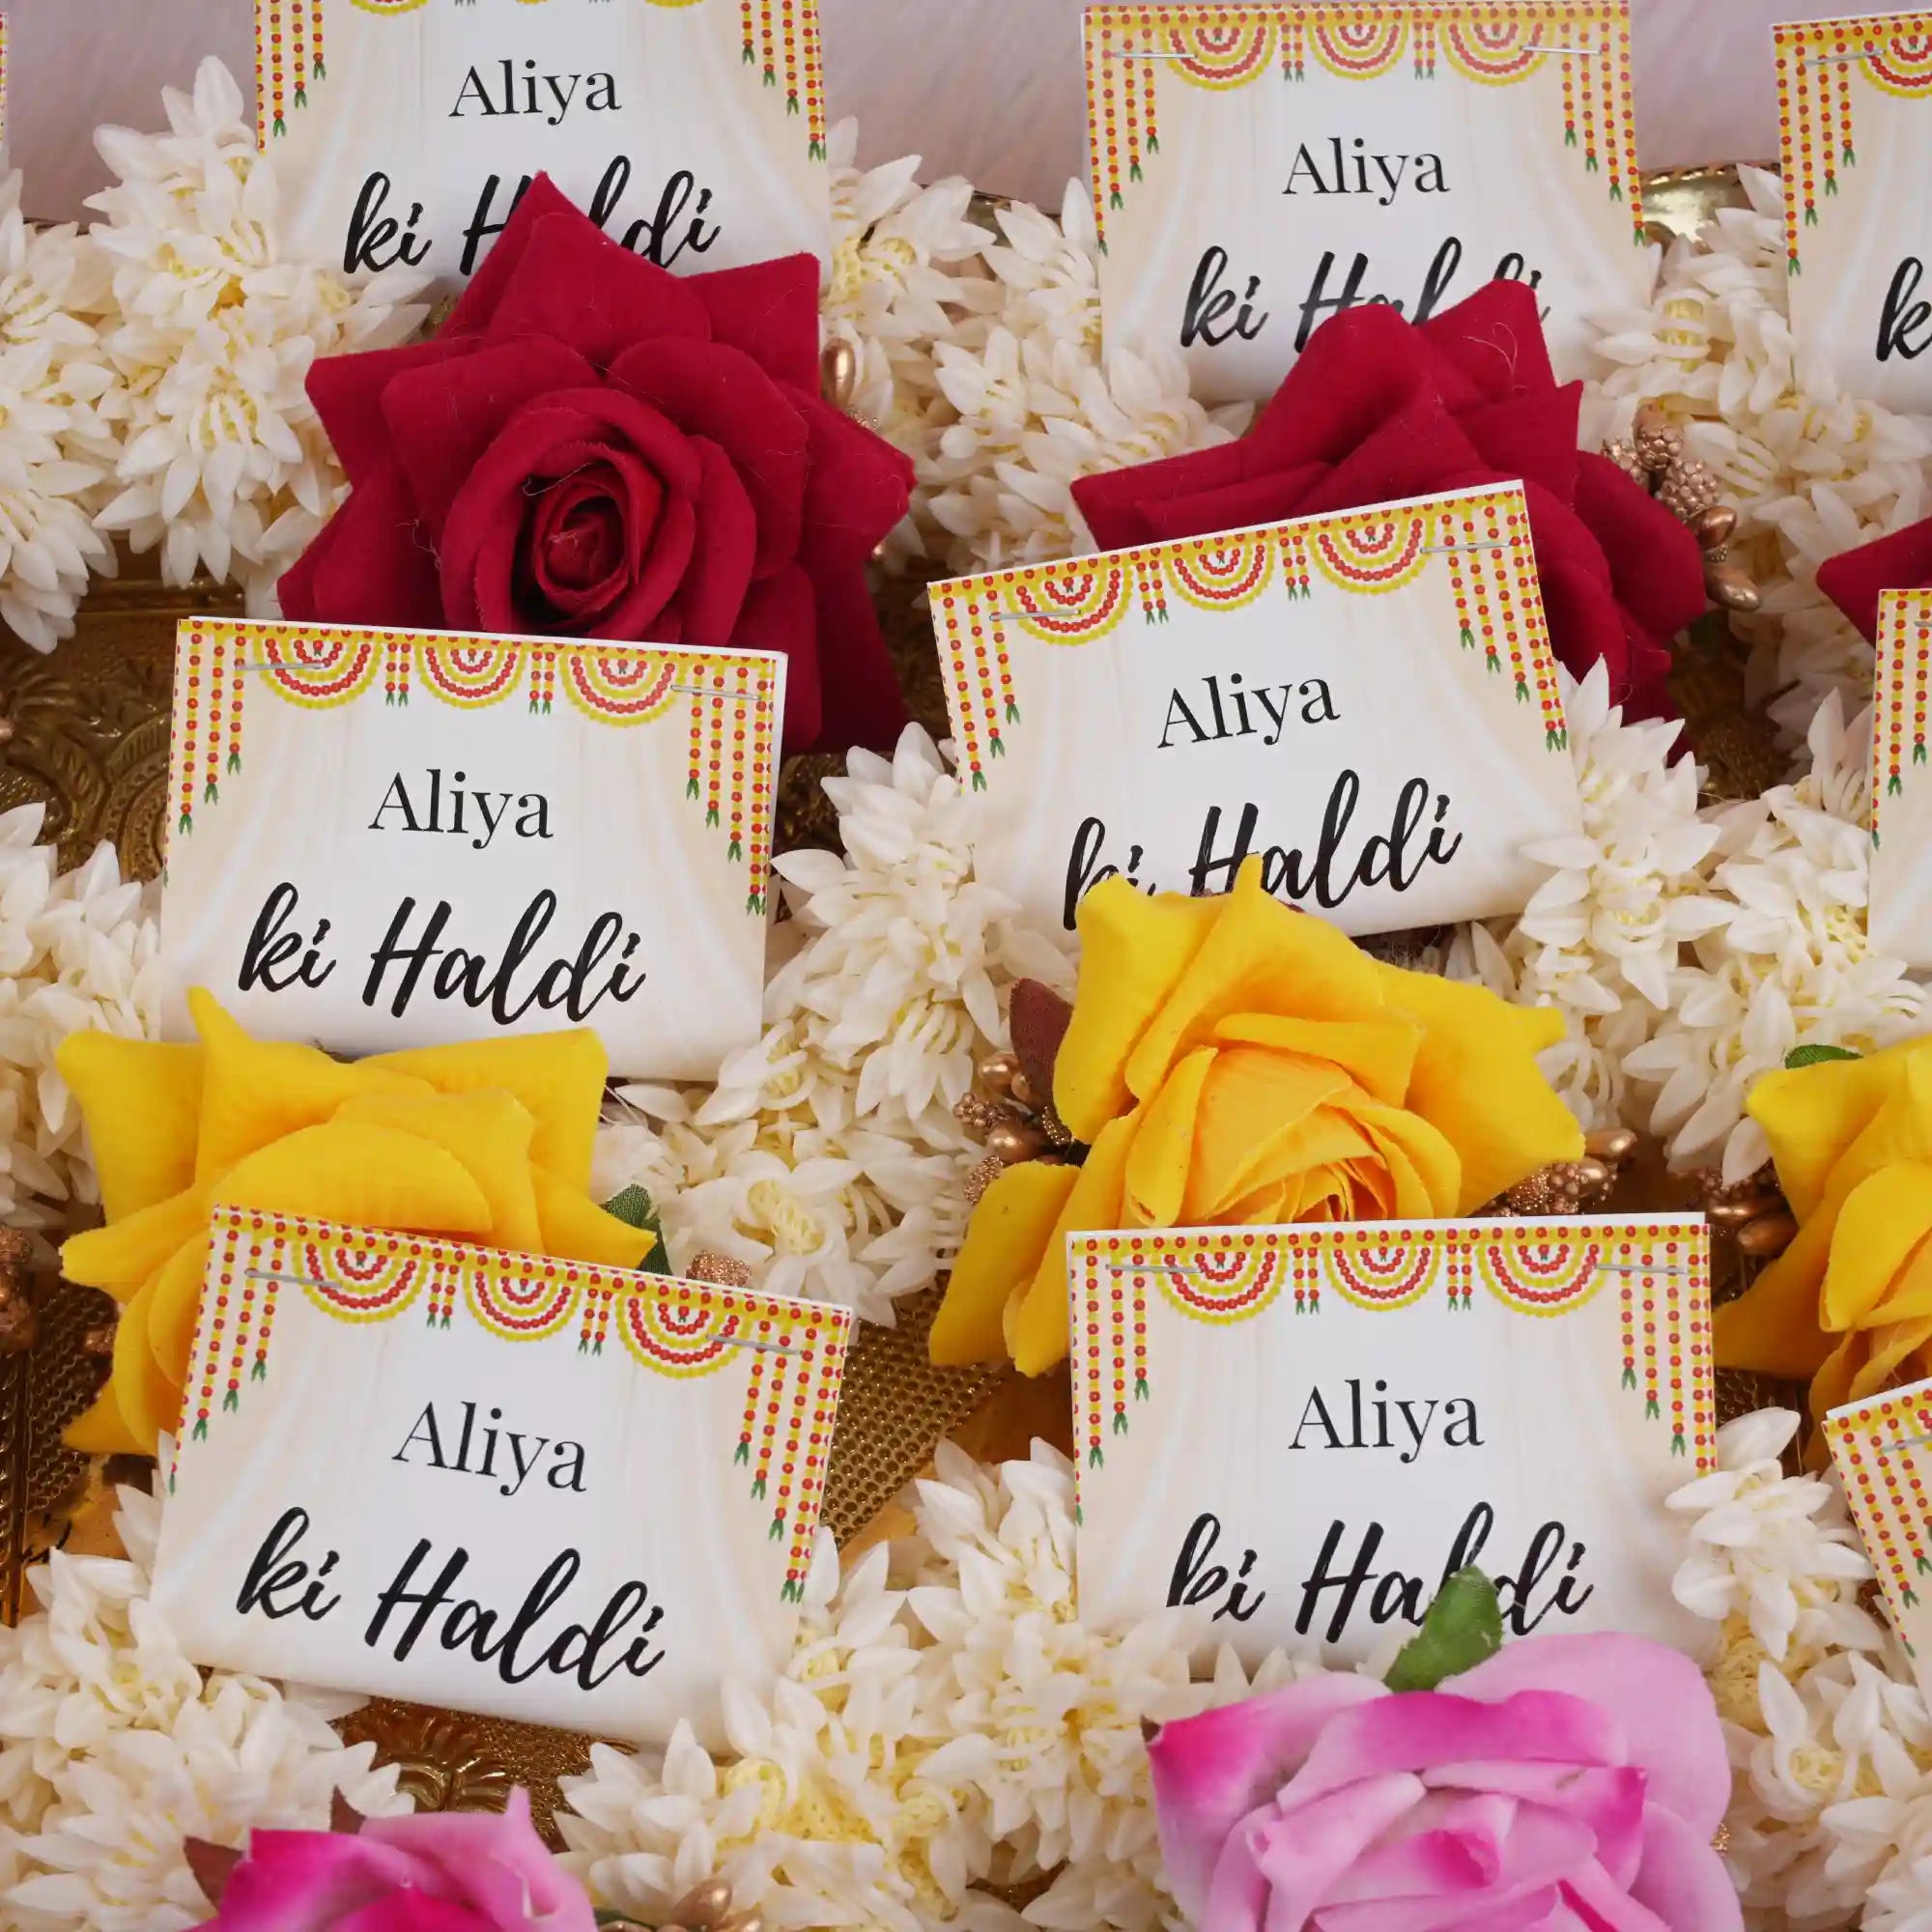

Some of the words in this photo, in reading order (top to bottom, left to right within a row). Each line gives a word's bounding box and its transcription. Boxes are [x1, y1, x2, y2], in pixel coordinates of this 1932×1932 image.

[449, 59, 623, 125] Aliya
[343, 171, 433, 274] ki
[459, 155, 721, 277] Hldi
[1283, 137, 1451, 207] Aliya
[1180, 245, 1269, 348] ki
[1876, 256, 1932, 362] k
[1157, 671, 1341, 749] Aliya
[369, 768, 553, 850] Aliya
[1188, 769, 1463, 909] Haldi
[238, 882, 337, 993] ki
[361, 889, 646, 1026] Haldi
[392, 1401, 586, 1496] Aliya
[1288, 1378, 1485, 1463] Aliya
[236, 1506, 341, 1621] ki
[364, 1538, 666, 1691] Haldi
